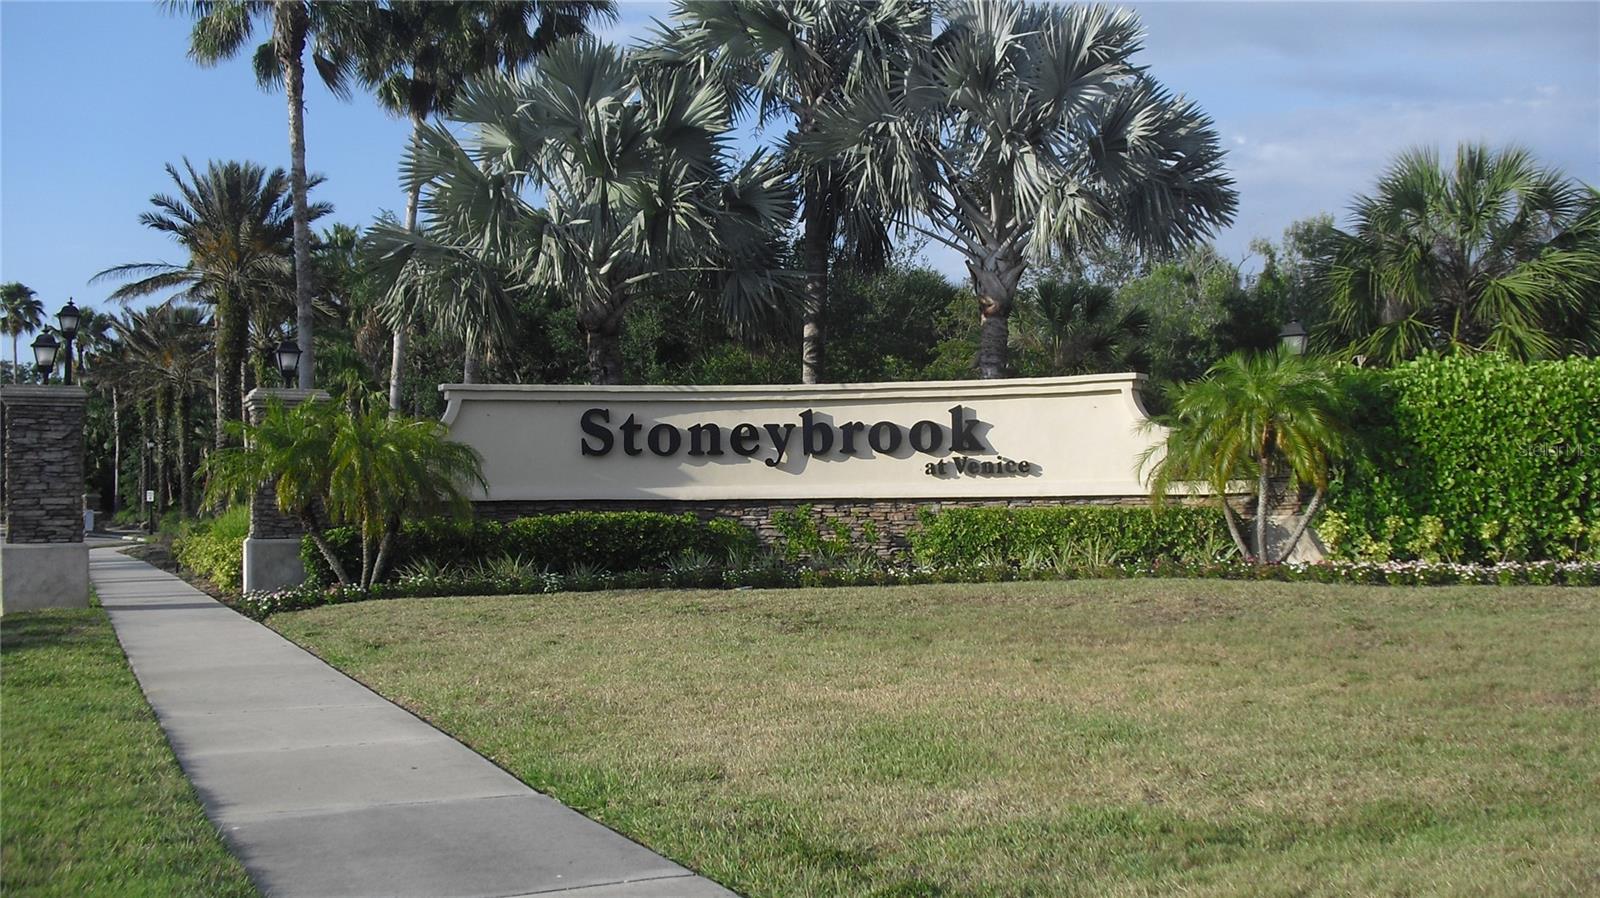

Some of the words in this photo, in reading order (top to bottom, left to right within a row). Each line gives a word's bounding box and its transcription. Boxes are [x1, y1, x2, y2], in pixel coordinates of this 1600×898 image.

[580, 405, 985, 467] Stoneybrook
[925, 459, 947, 475] at
[952, 456, 1031, 475] Venice
